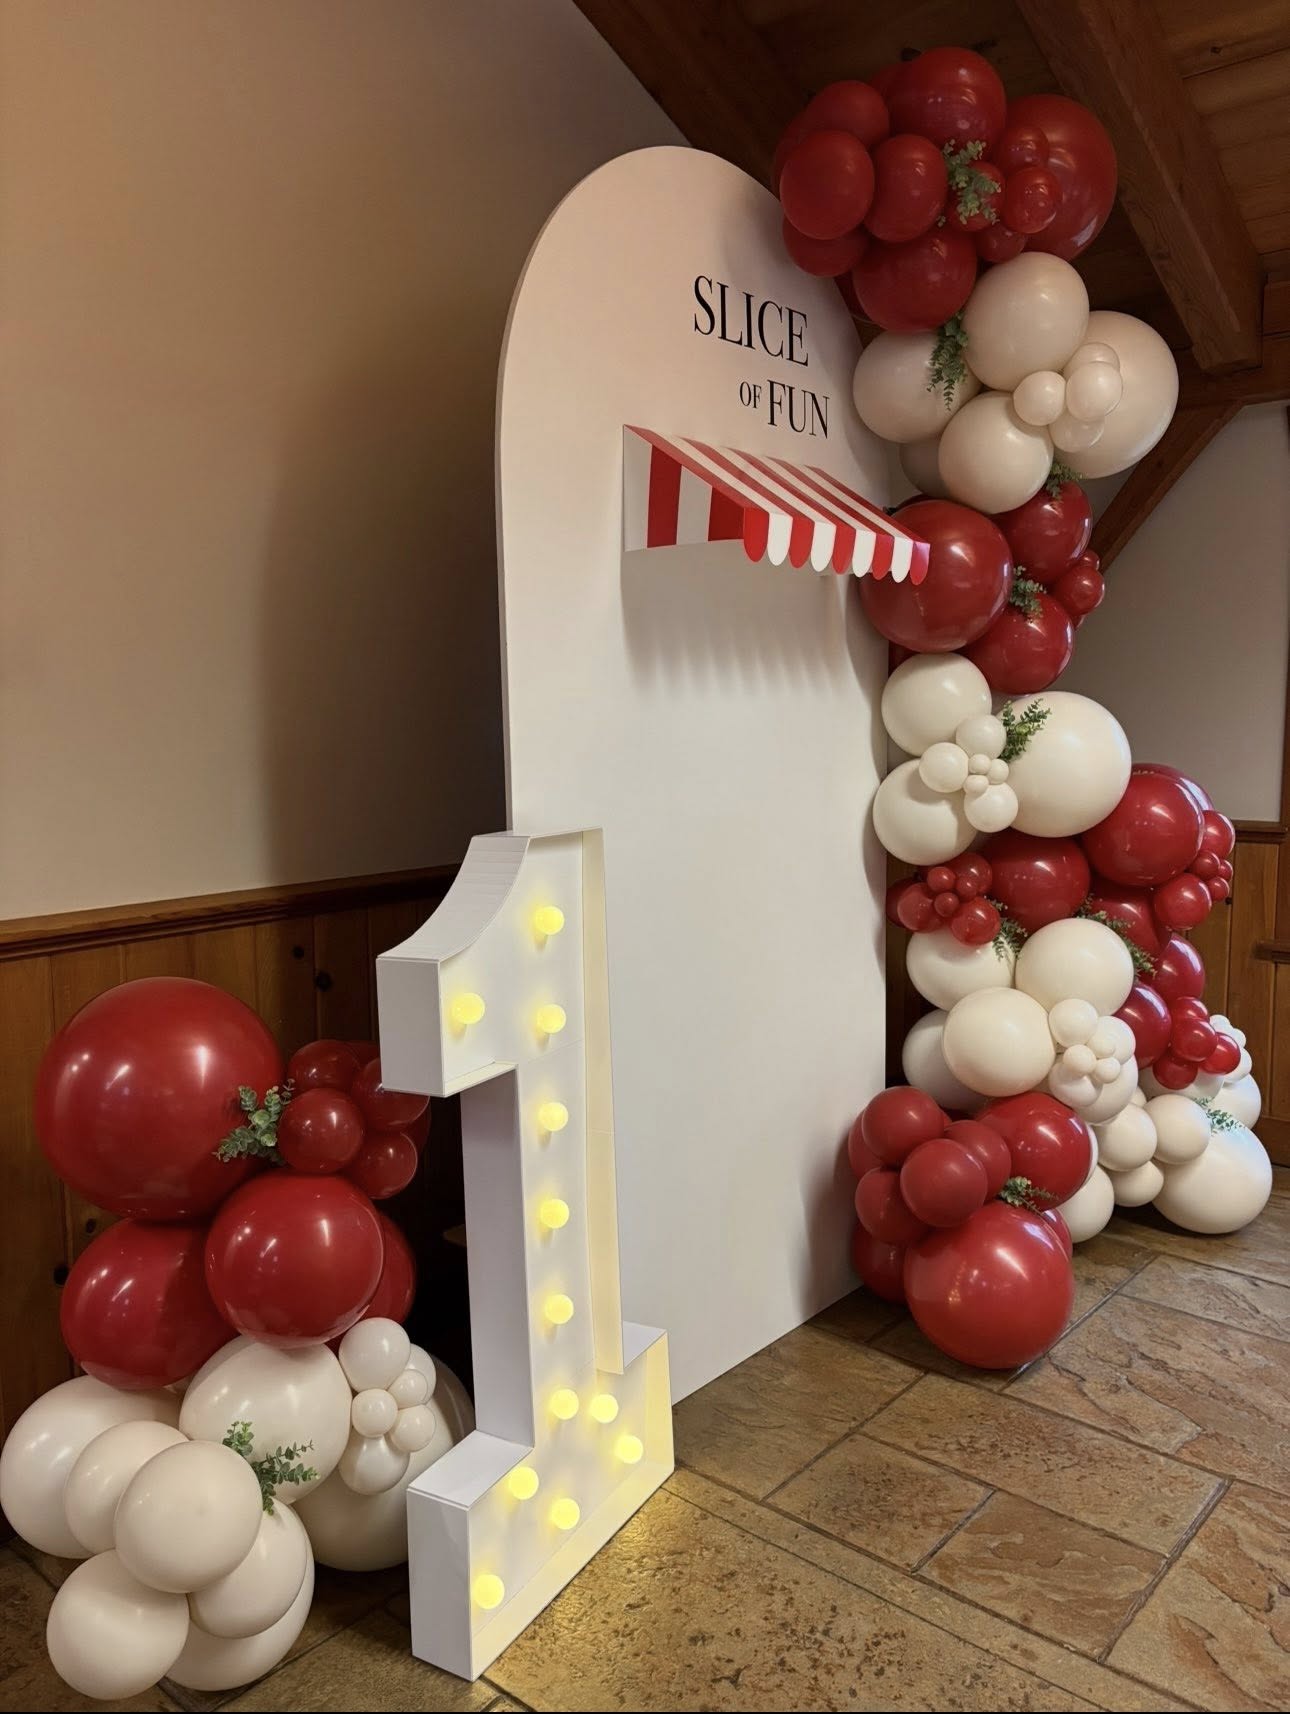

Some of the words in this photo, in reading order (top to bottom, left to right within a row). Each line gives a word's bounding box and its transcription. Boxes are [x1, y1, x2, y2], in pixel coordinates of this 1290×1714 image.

[694, 275, 809, 366] SLICE
[739, 381, 762, 409] OF
[767, 379, 830, 439] FUN
[377, 827, 675, 1681] 1
